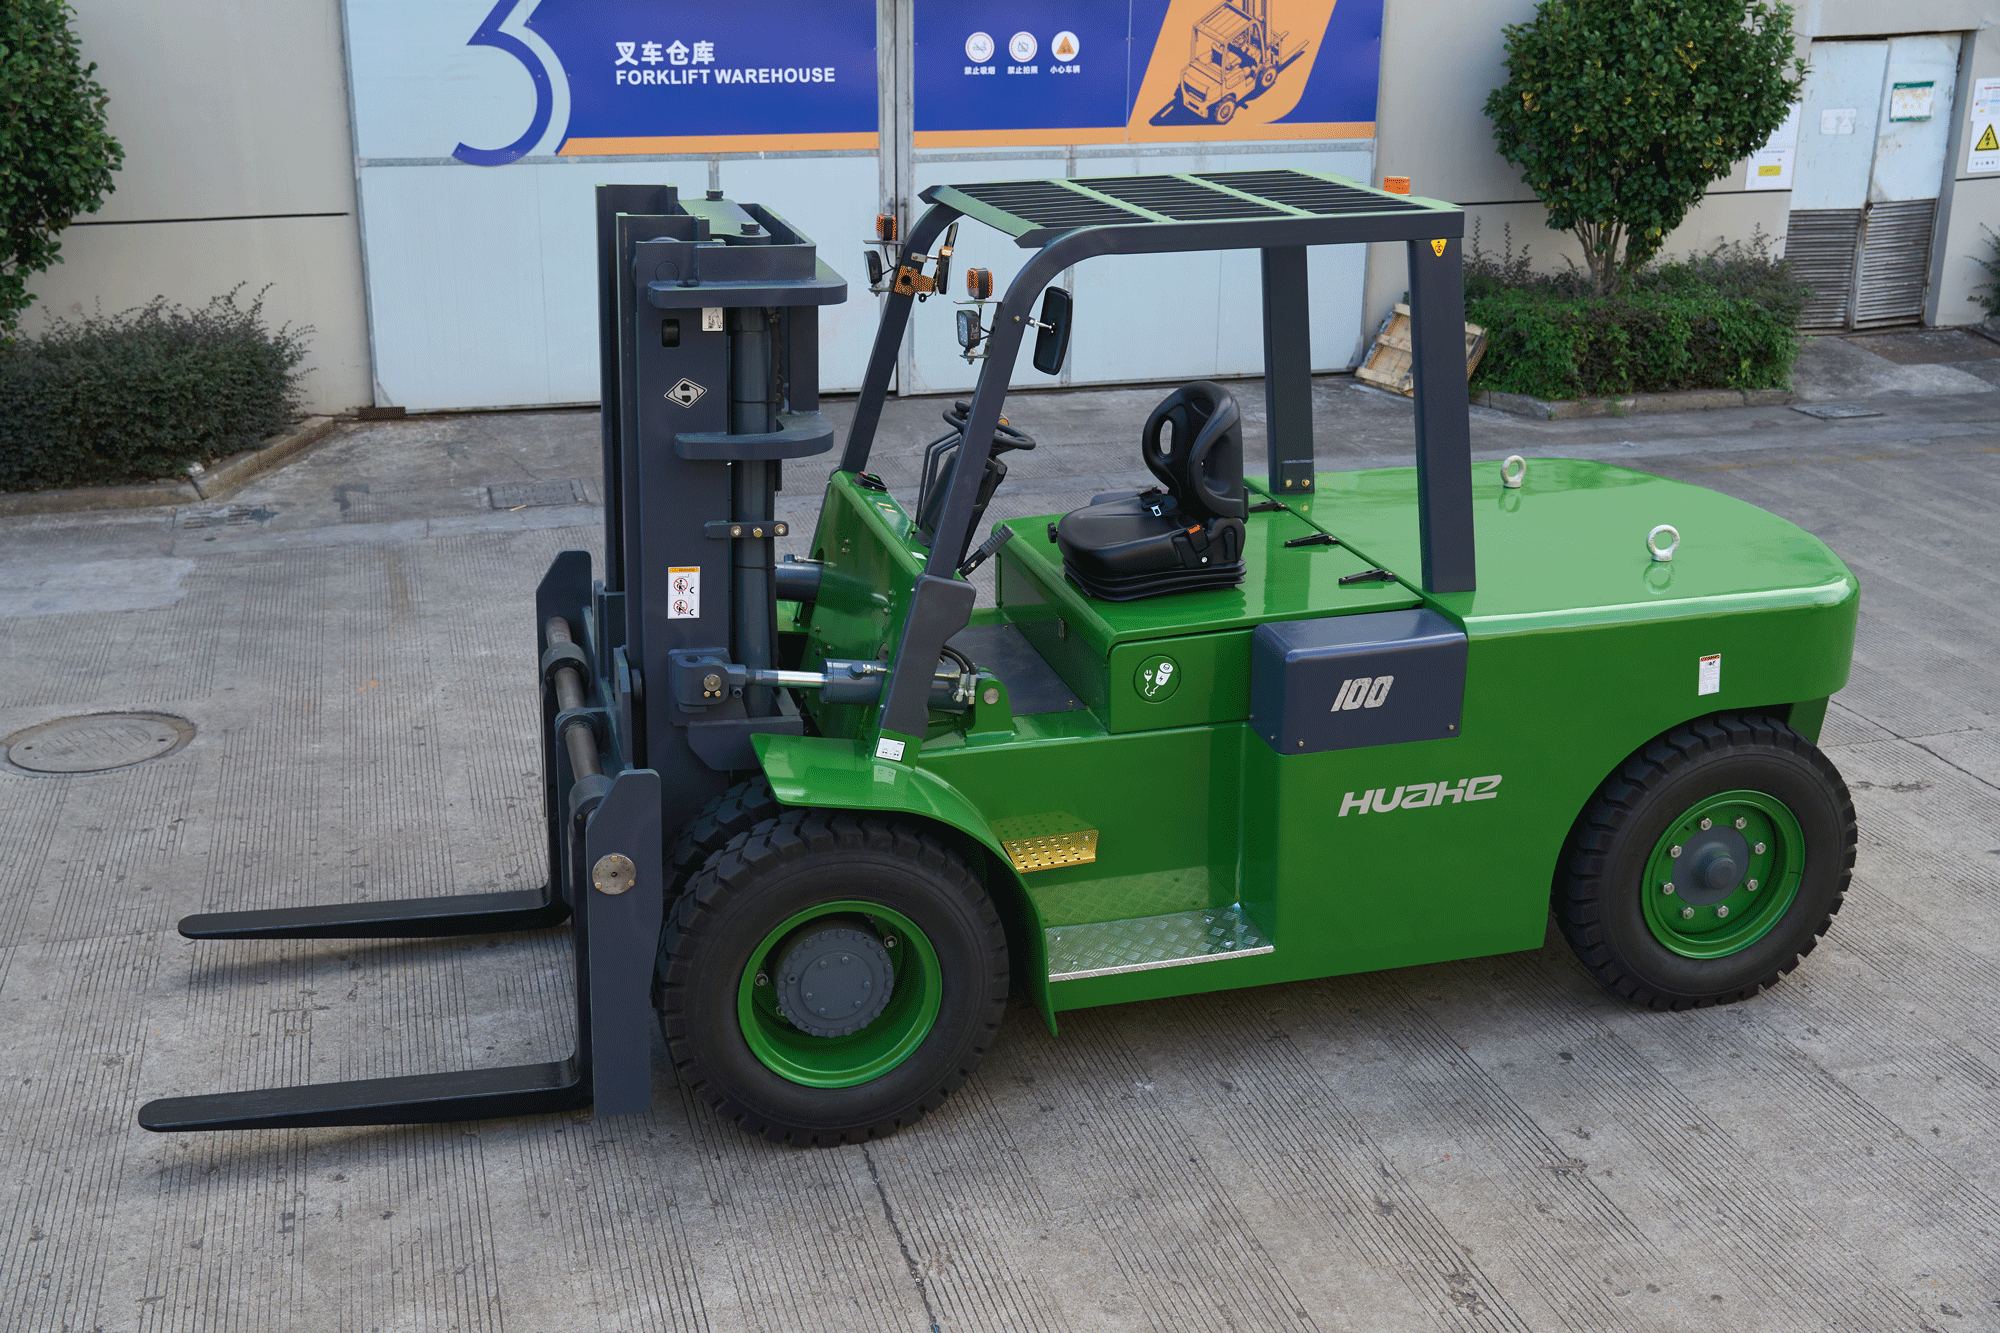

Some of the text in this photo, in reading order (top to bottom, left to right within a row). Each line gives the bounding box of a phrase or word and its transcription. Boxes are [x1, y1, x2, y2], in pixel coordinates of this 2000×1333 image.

[614, 39, 715, 66] 叉车仓库
[616, 67, 836, 85] FORKLIFT WAREHOUSE
[1330, 675, 1395, 712] 100
